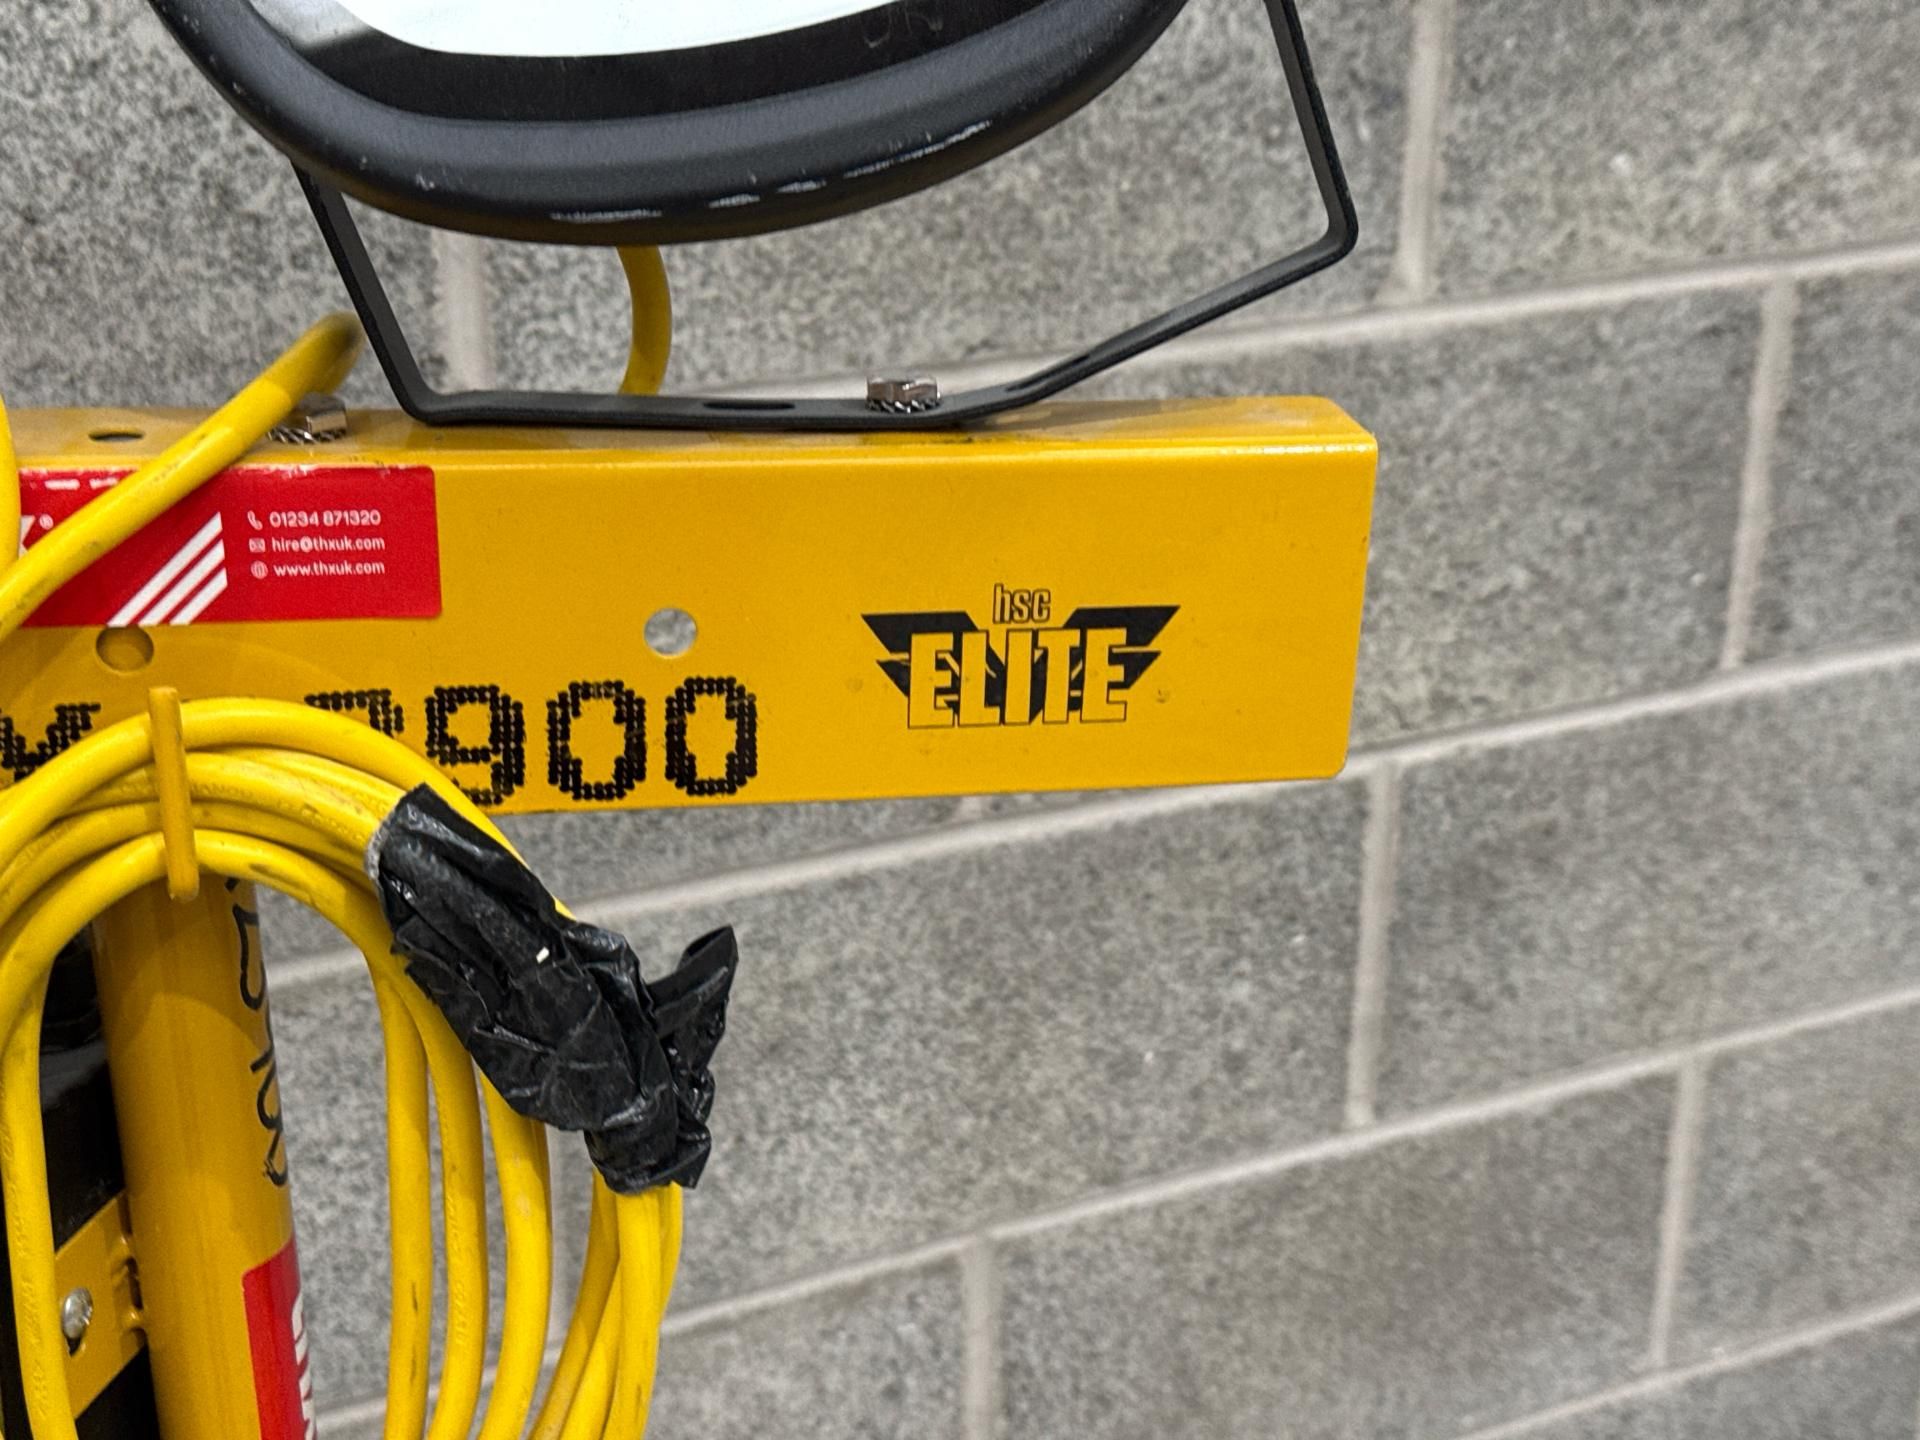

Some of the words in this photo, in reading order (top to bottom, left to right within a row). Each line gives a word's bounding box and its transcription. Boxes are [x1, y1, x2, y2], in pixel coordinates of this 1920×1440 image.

[269, 511, 320, 527] 01234
[322, 509, 382, 526] 871320
[271, 536, 385, 552] hire@thxuk.com
[273, 560, 385, 576] www.thxuk.com
[993, 583, 1051, 624] hsc
[908, 627, 1127, 729] ELITE
